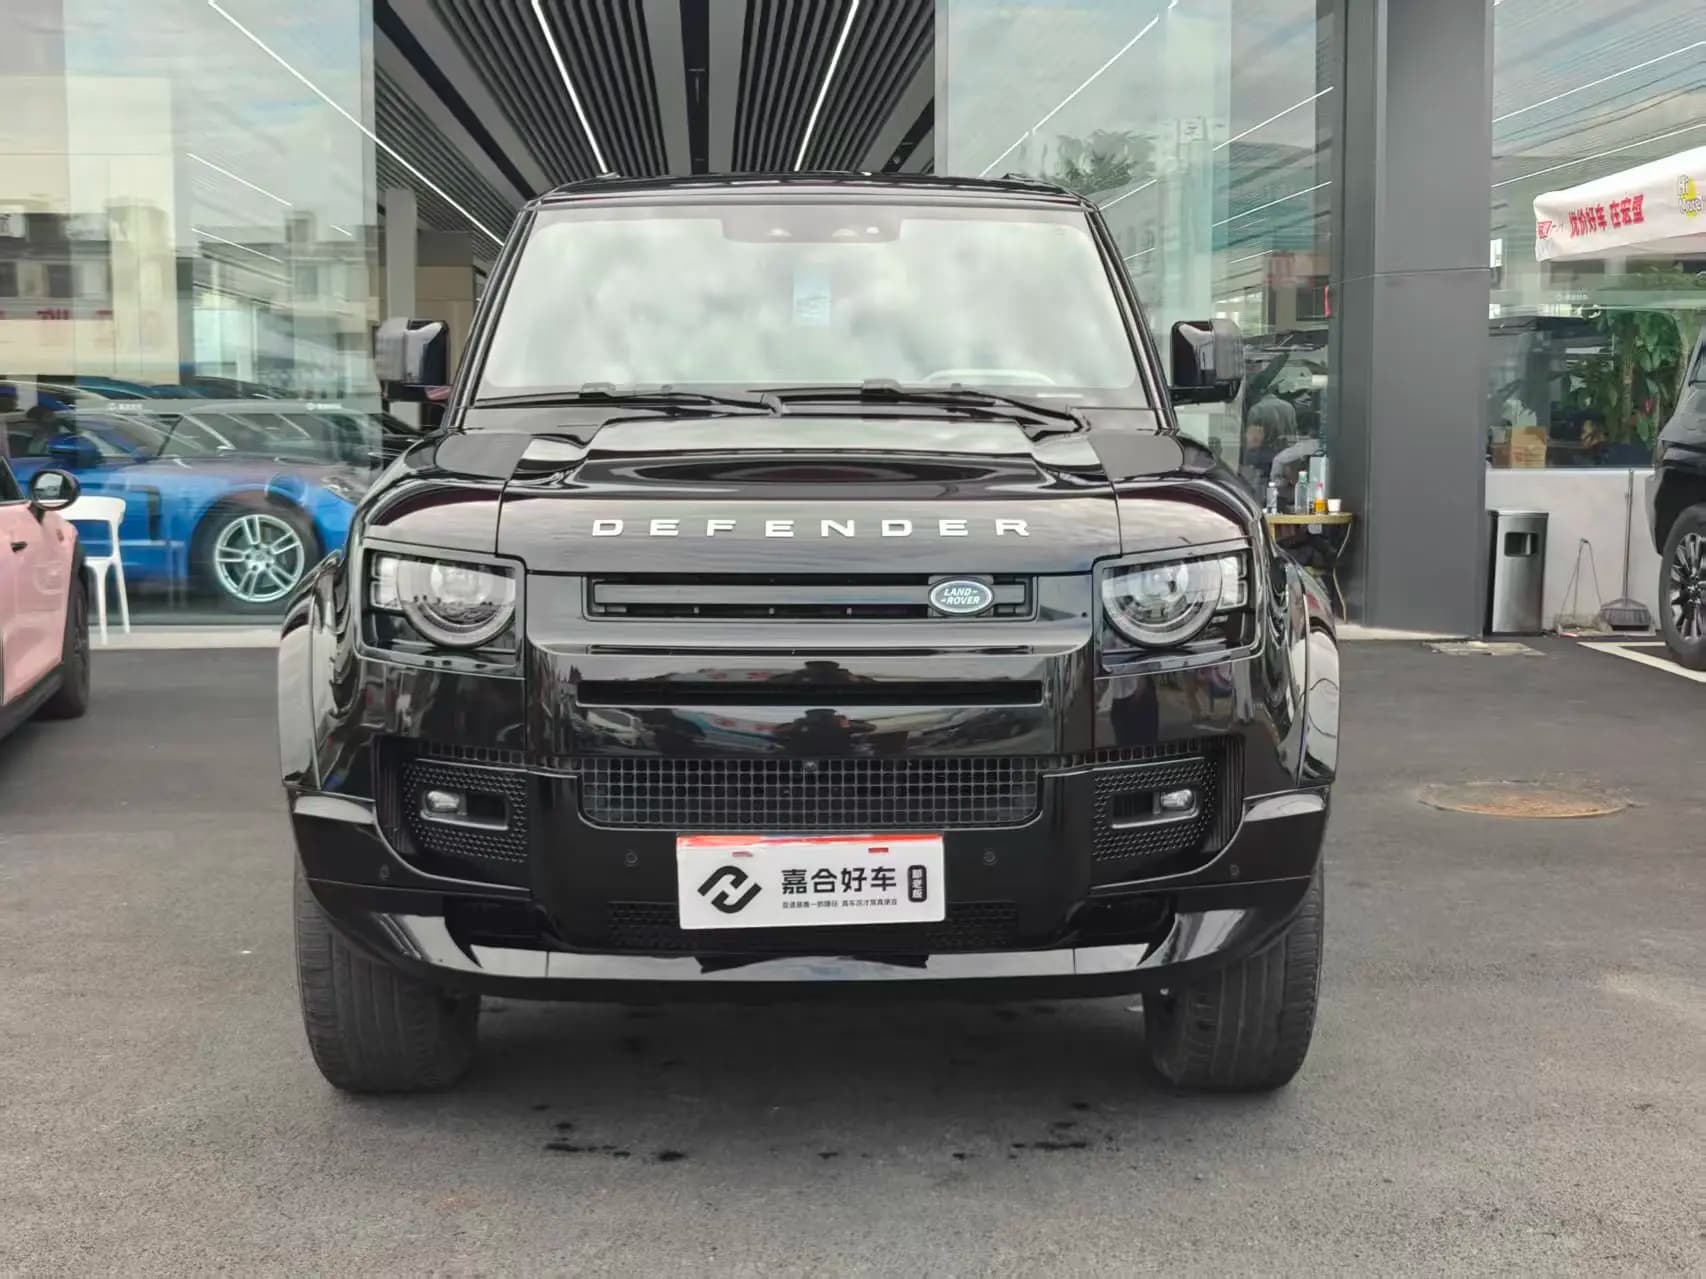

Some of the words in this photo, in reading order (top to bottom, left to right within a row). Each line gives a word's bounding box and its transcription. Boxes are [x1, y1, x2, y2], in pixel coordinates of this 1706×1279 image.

[591, 518, 1030, 538] DEFENDER
[781, 866, 897, 895] 嘉合好车
